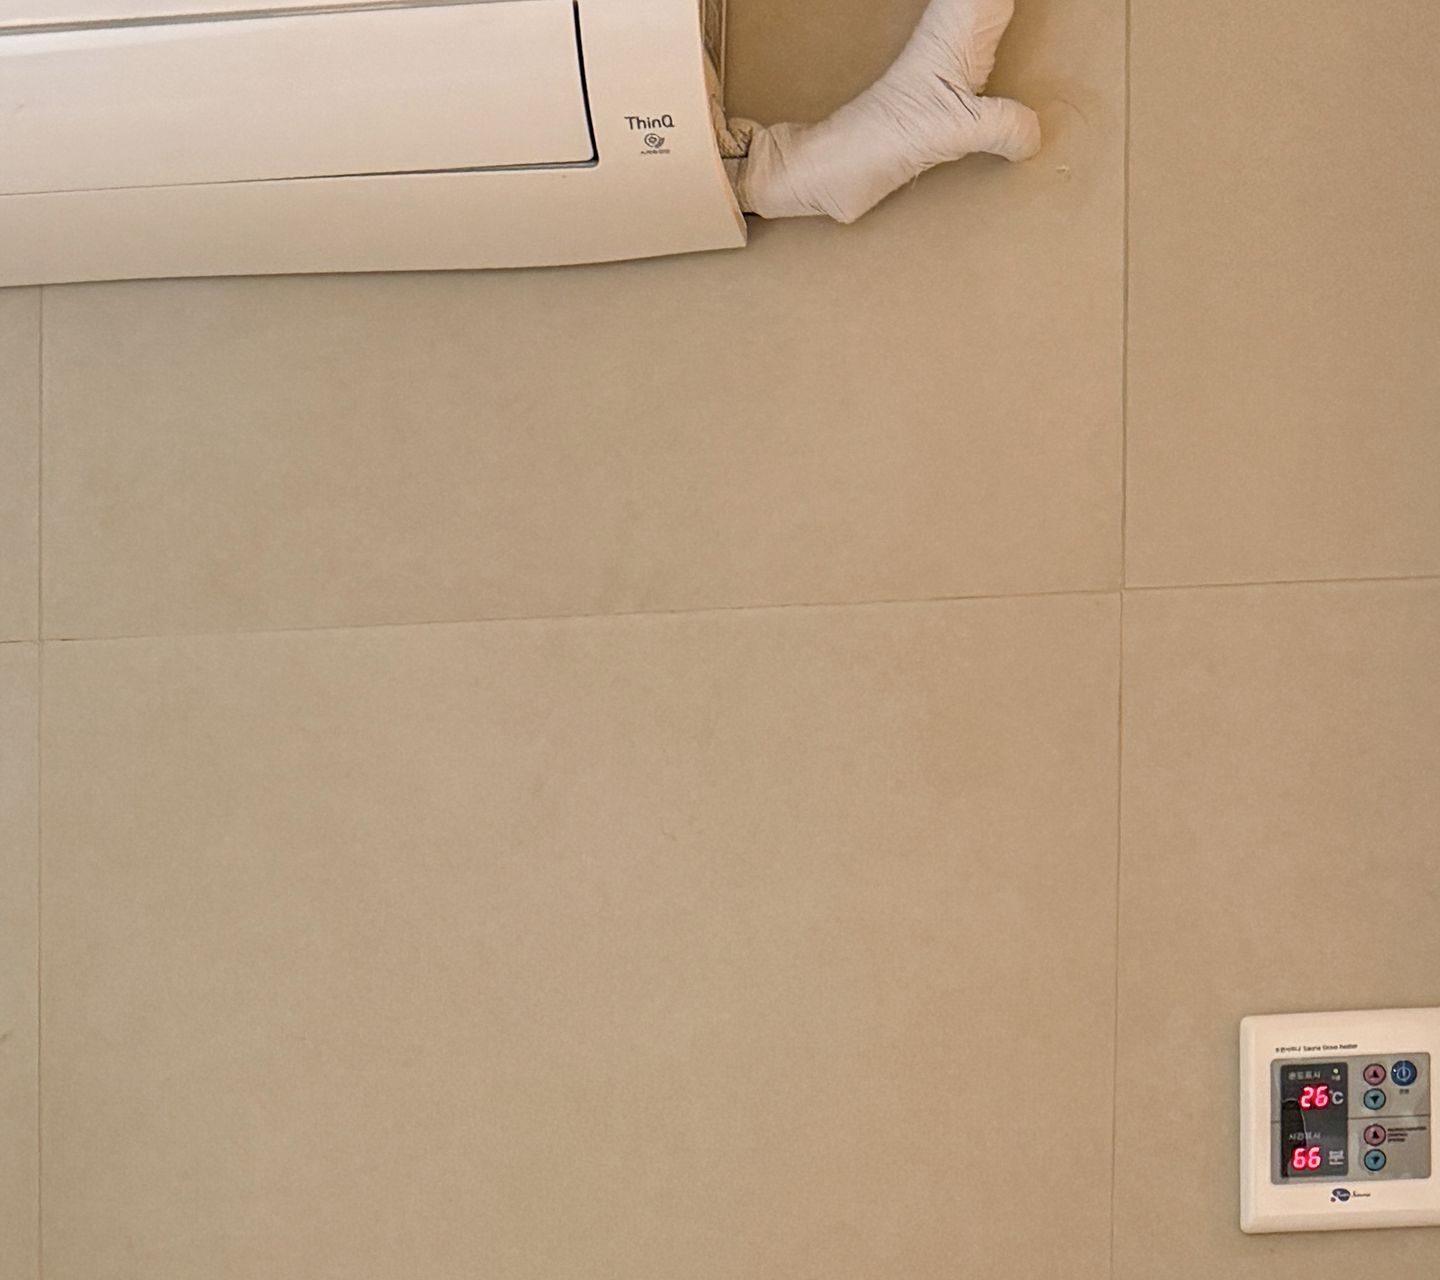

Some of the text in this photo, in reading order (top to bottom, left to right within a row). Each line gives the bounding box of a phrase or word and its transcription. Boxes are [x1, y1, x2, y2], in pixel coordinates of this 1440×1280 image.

[624, 114, 675, 130] ThinQ
[1300, 1086, 1328, 1108] 26
[1292, 1147, 1321, 1169] 66
